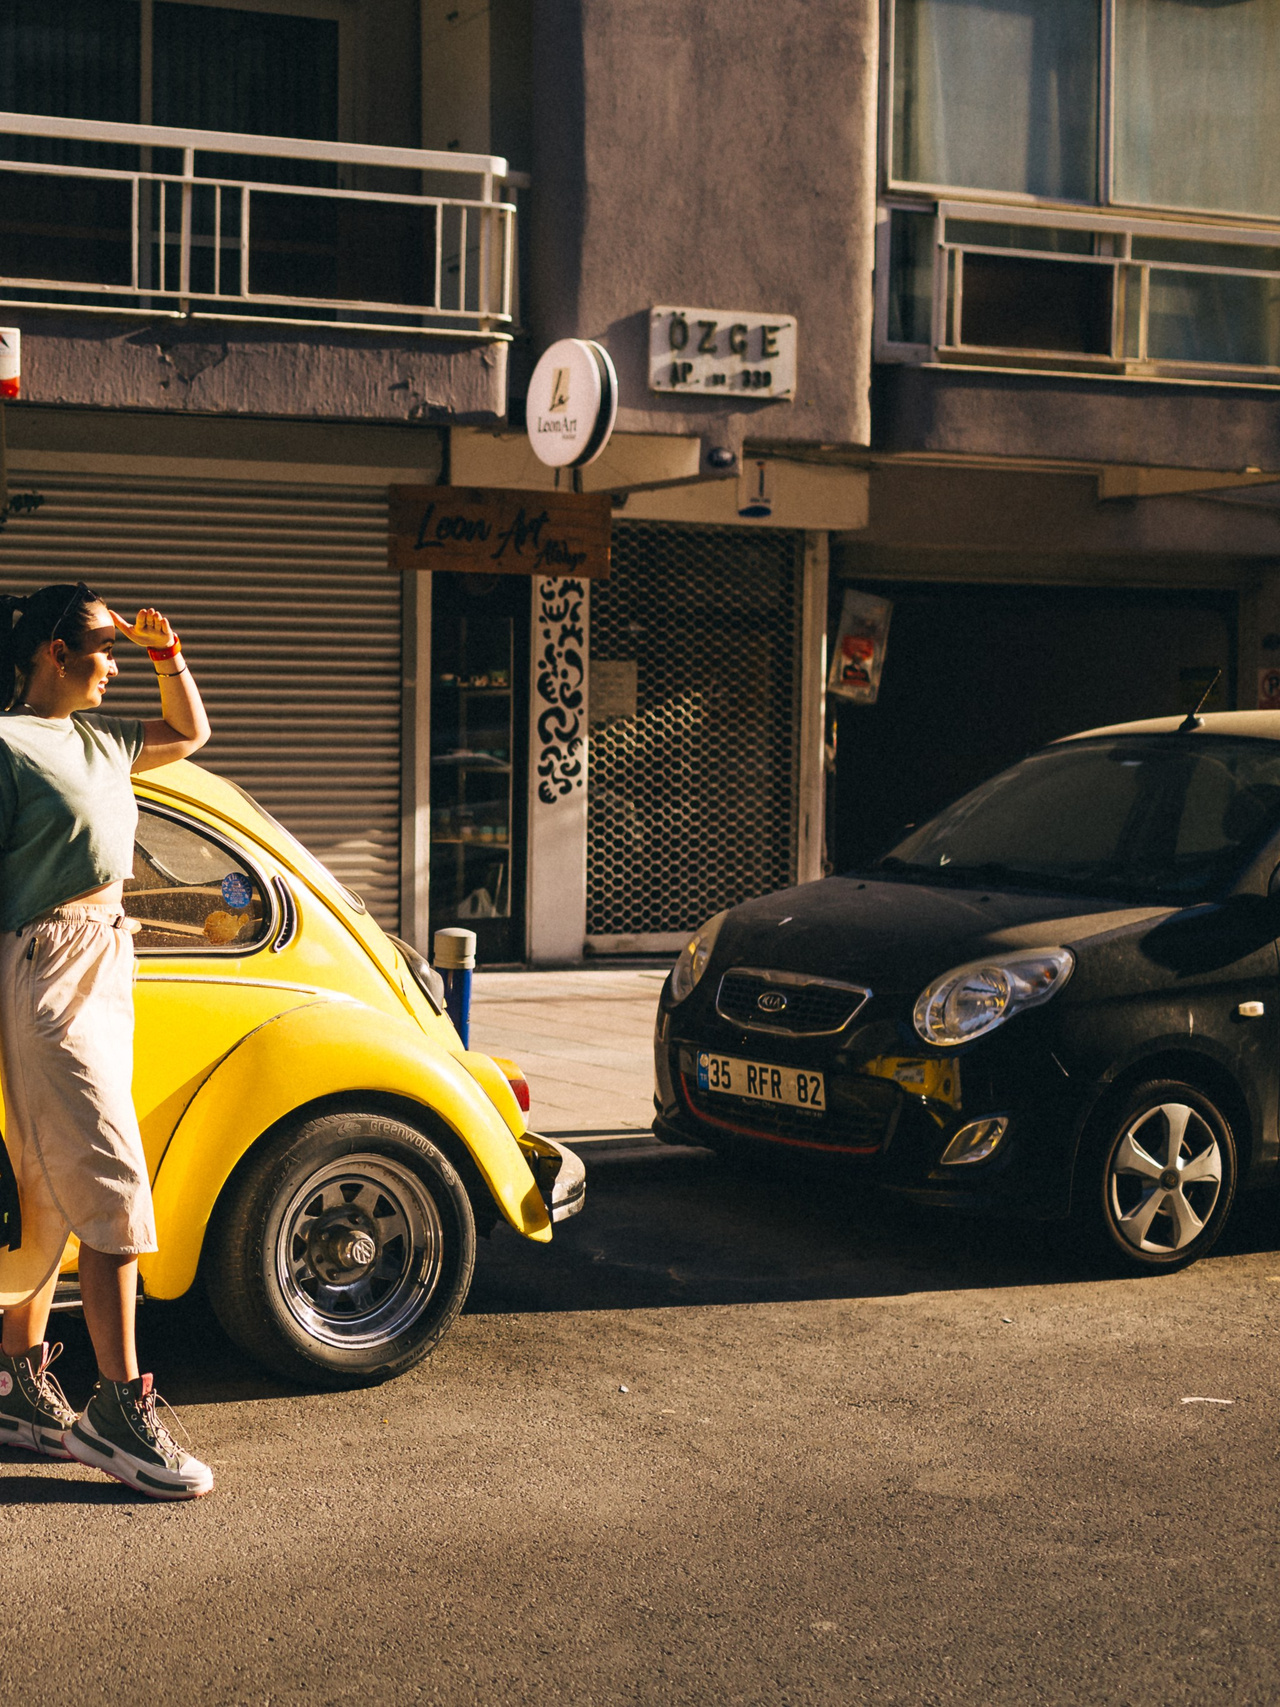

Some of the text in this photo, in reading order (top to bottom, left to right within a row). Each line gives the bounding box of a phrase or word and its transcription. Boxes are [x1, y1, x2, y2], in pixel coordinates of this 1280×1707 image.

[669, 311, 781, 358] ÖZGE
[709, 1059, 732, 1090] 35
[746, 1065, 783, 1100] RFR
[796, 1073, 823, 1107] 82
[370, 1120, 436, 1158] Greenways
